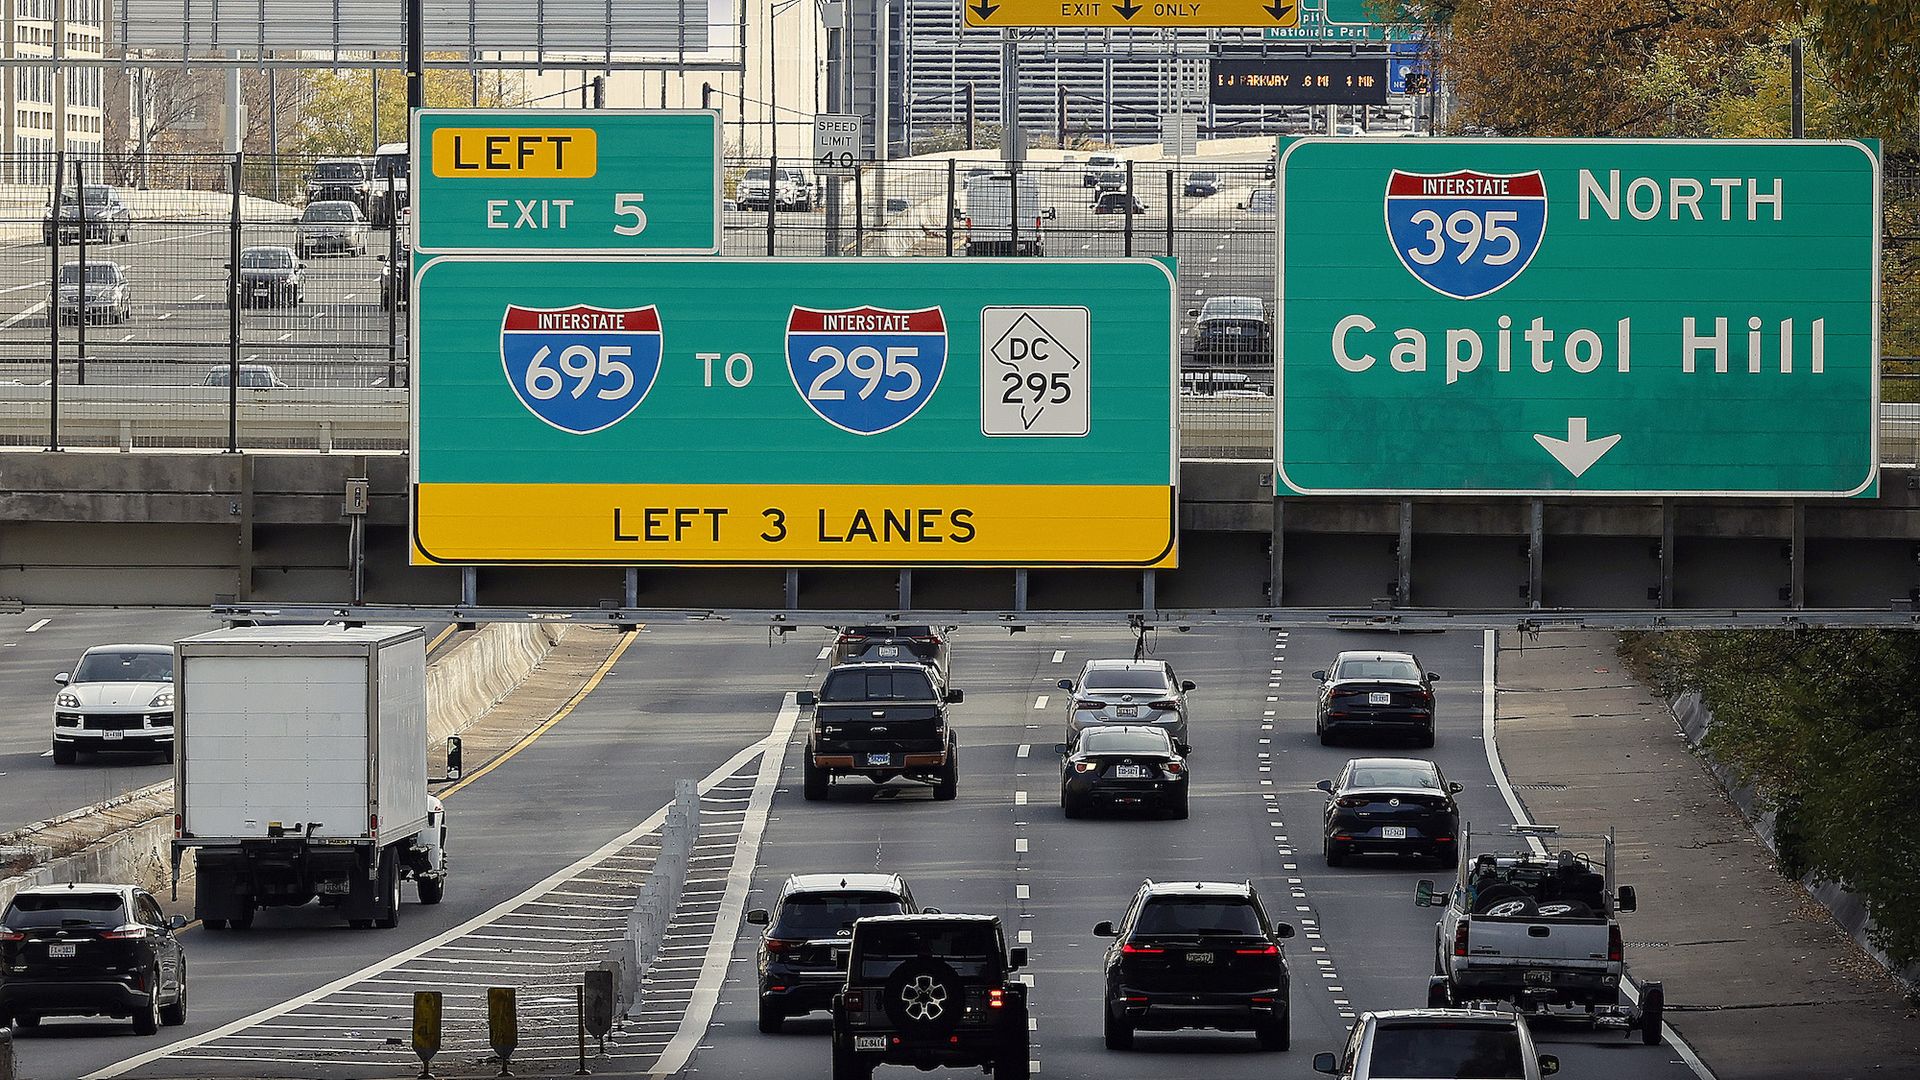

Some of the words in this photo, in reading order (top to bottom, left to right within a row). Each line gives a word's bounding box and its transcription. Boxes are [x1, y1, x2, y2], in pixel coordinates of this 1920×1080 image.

[1061, 3, 1101, 17] EXIT
[1153, 2, 1201, 17] ONLY
[818, 121, 858, 132] SPEED
[821, 136, 852, 146] LIMIT
[454, 135, 572, 170] LEFT
[819, 151, 853, 168] 40
[1422, 178, 1510, 196] INTERSTATE
[1579, 169, 1782, 221] NORTH
[487, 199, 574, 229] EXIT
[613, 193, 646, 236] 5
[1407, 209, 1522, 266] 395
[537, 313, 625, 331] INTERSTATE
[822, 314, 910, 332] INTERSTATE
[1009, 337, 1048, 362] DC
[1331, 314, 1630, 385] Capitol
[1682, 316, 1825, 374] Hill
[525, 345, 635, 400] 695
[695, 352, 754, 388] TO
[808, 346, 922, 401] 295
[1002, 372, 1071, 404] 295
[613, 508, 729, 542] LEFT
[760, 508, 786, 543] 3
[818, 508, 976, 544] LANES
